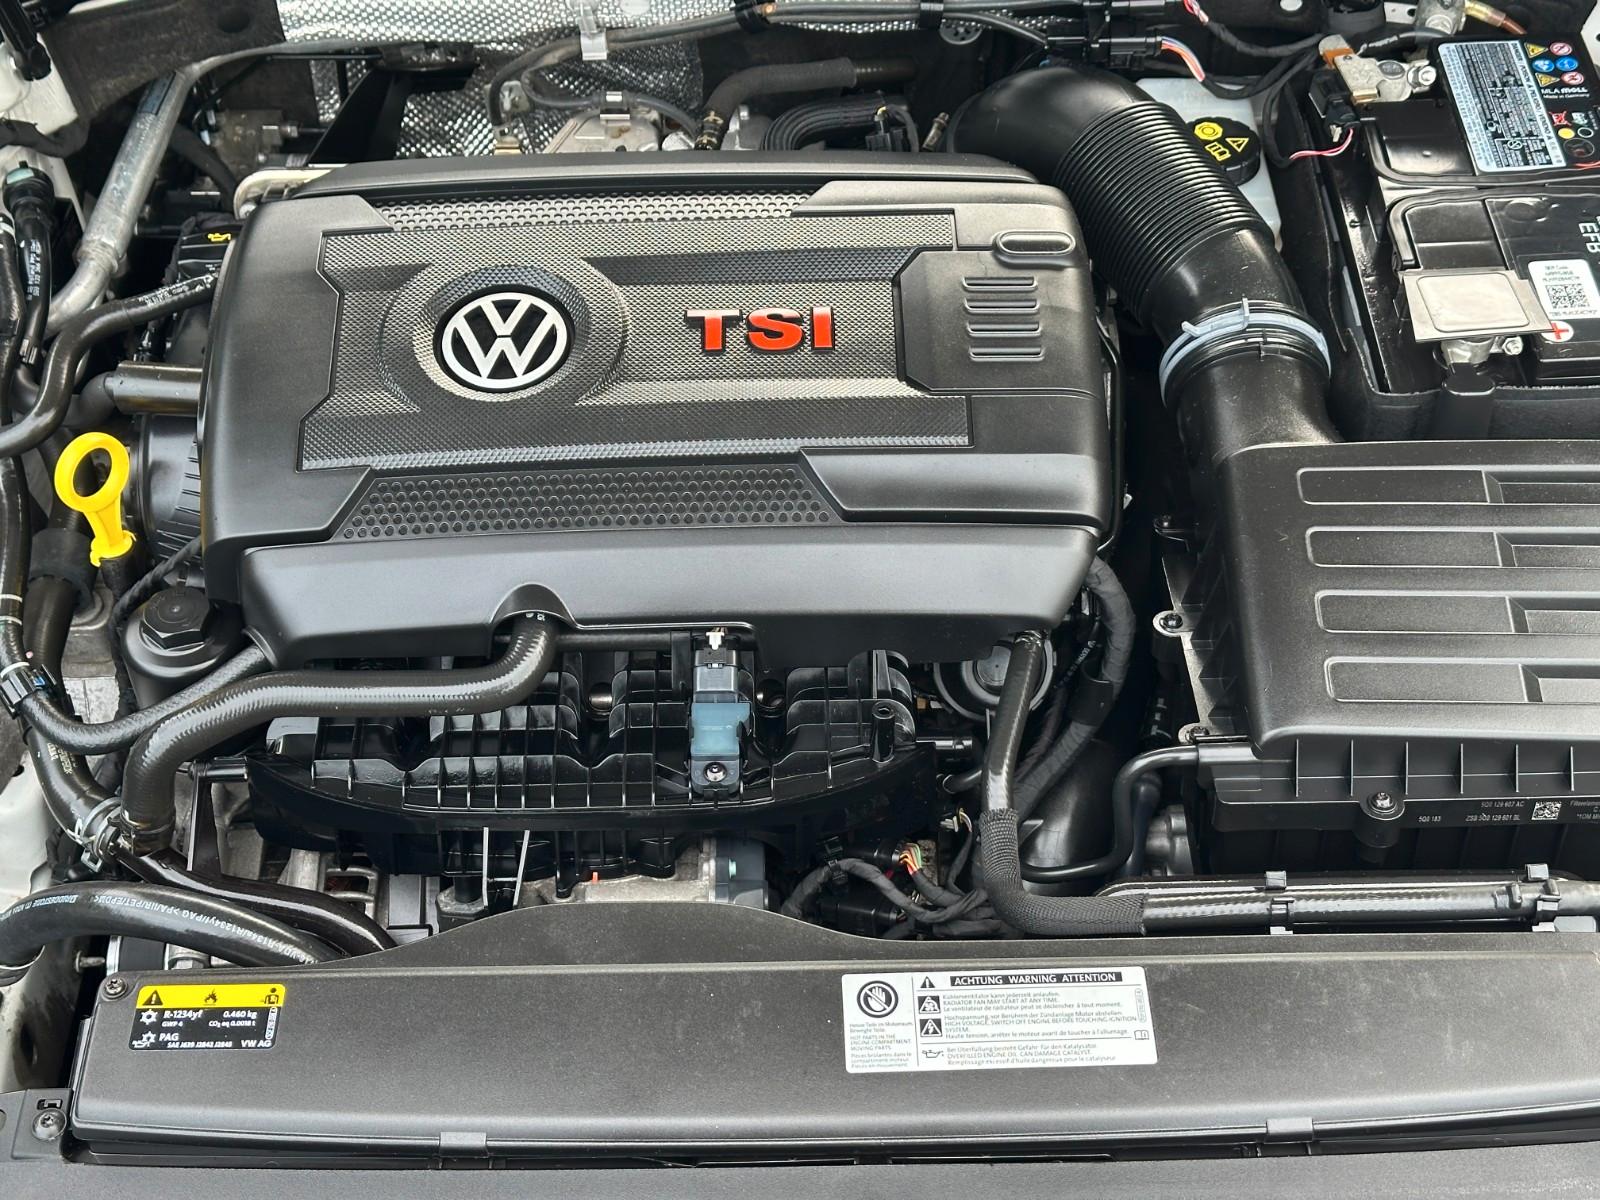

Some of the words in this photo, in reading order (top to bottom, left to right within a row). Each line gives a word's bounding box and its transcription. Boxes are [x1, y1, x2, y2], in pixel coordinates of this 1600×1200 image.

[1579, 222, 1600, 253] EFB
[685, 305, 835, 354] TSI
[954, 976, 1003, 985] ACHTUNG
[1008, 974, 1057, 984] WARNING
[1061, 972, 1116, 983] ATTENTION
[163, 1010, 203, 1020] R-1234yf
[223, 1010, 246, 1018] 0.460
[247, 1010, 258, 1020] kg
[159, 1032, 179, 1041] PAG
[240, 1039, 257, 1047] VW
[257, 1039, 272, 1047] AG
